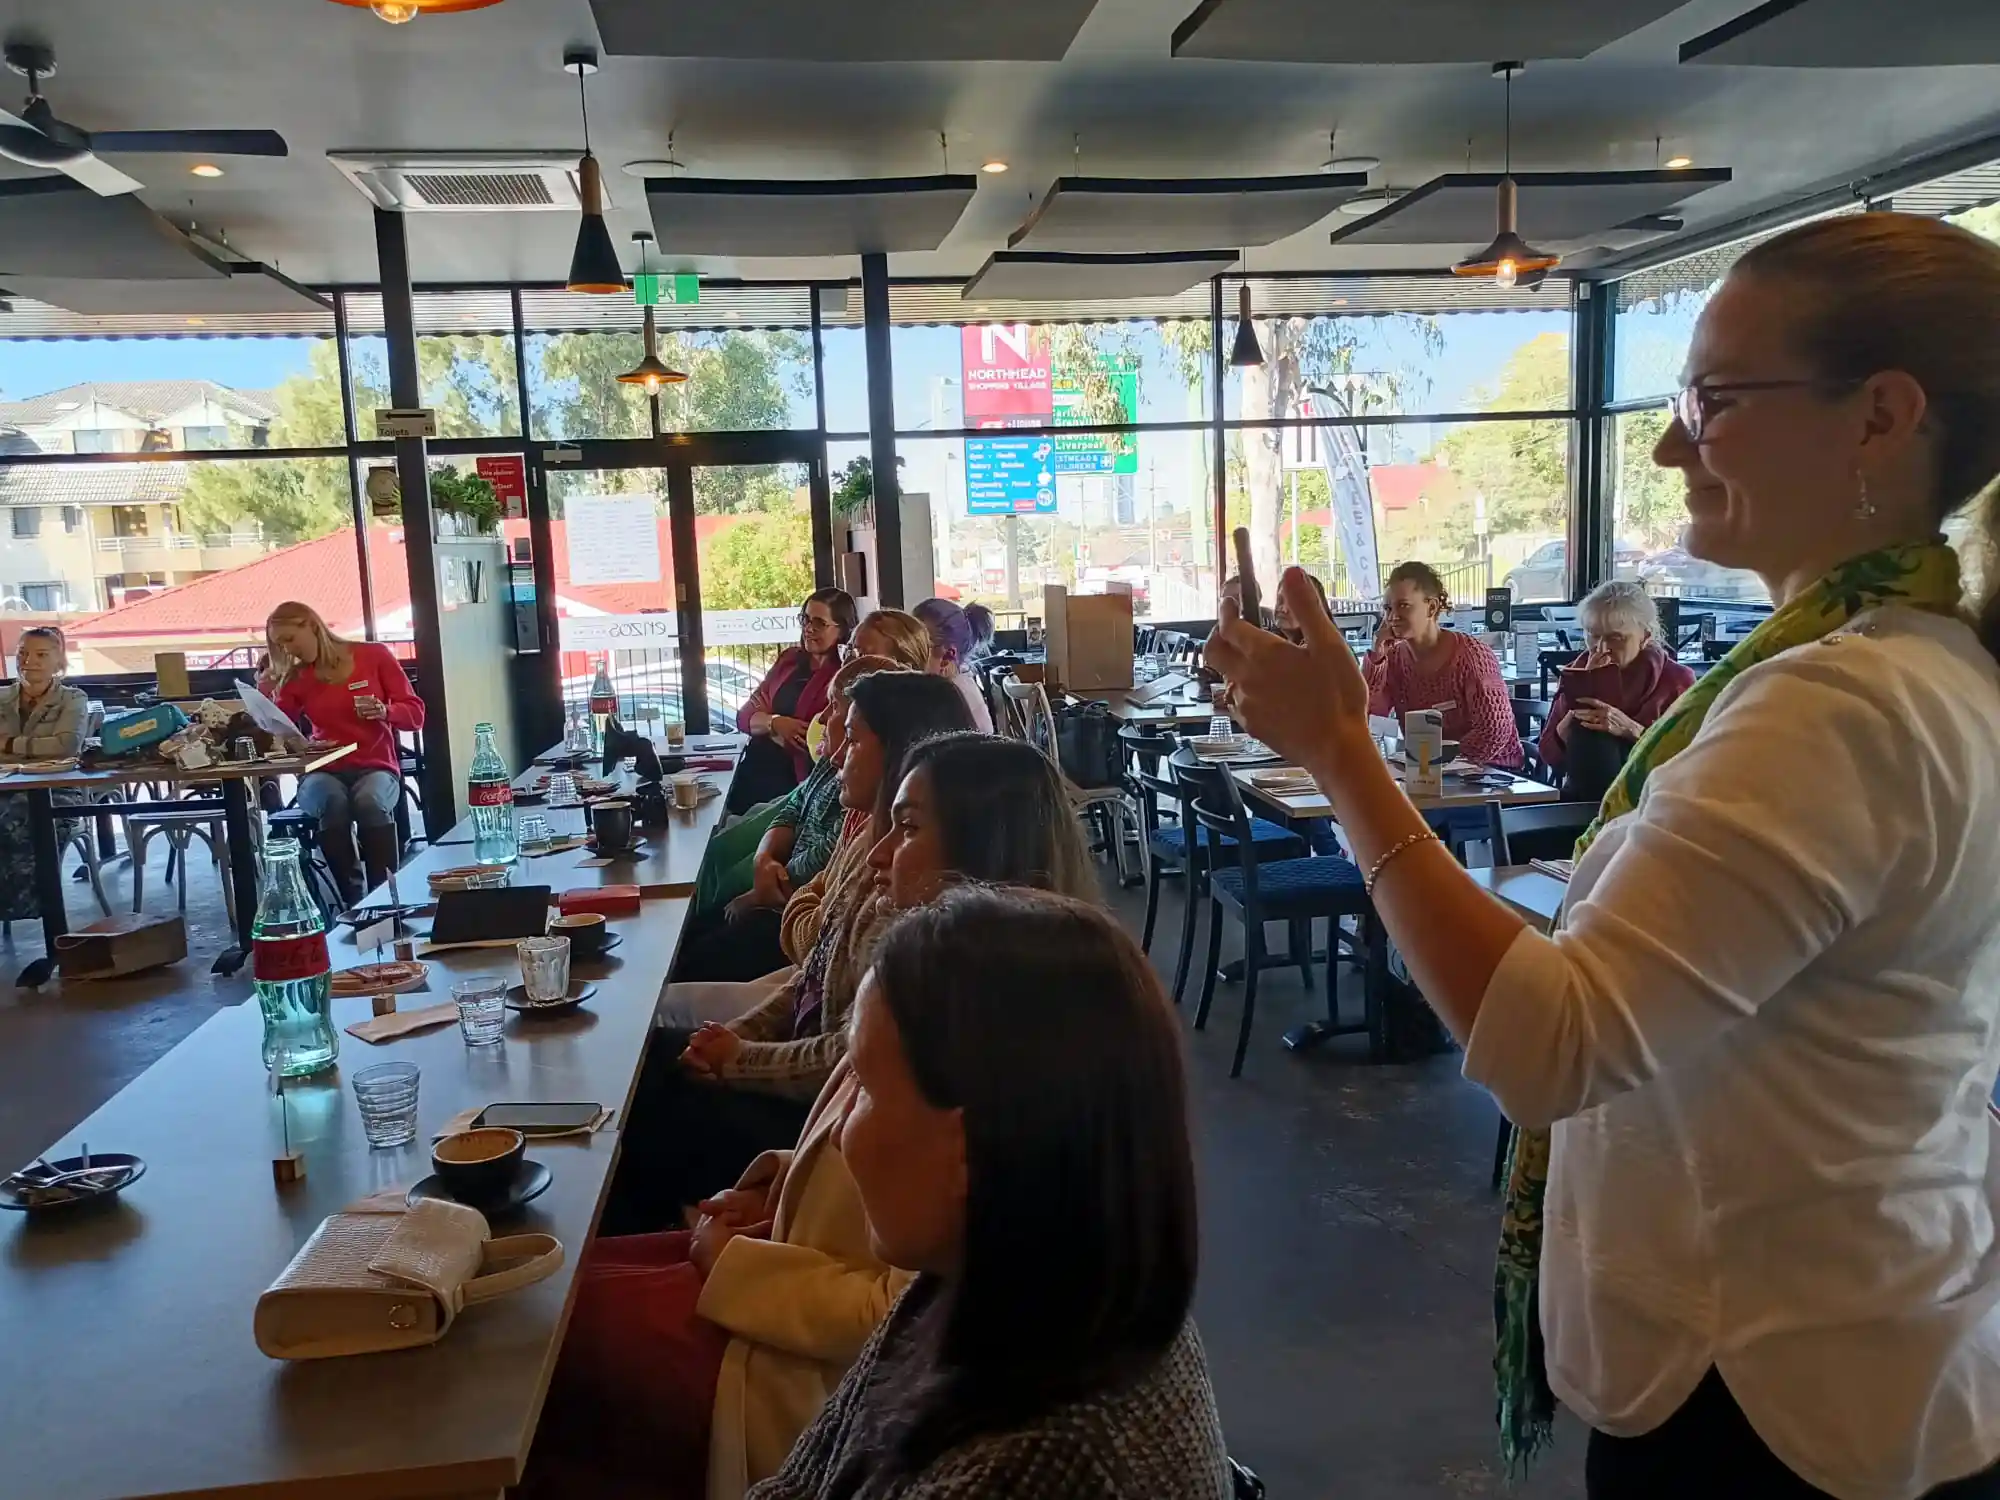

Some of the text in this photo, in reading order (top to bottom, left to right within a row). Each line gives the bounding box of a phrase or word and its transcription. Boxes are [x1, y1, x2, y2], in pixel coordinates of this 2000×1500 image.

[981, 324, 1029, 365] N
[968, 368, 1047, 381] NORTHMEAD
[379, 428, 409, 436] Toilets
[1056, 441, 1102, 450] Liverpool
[186, 656, 208, 665] offee
